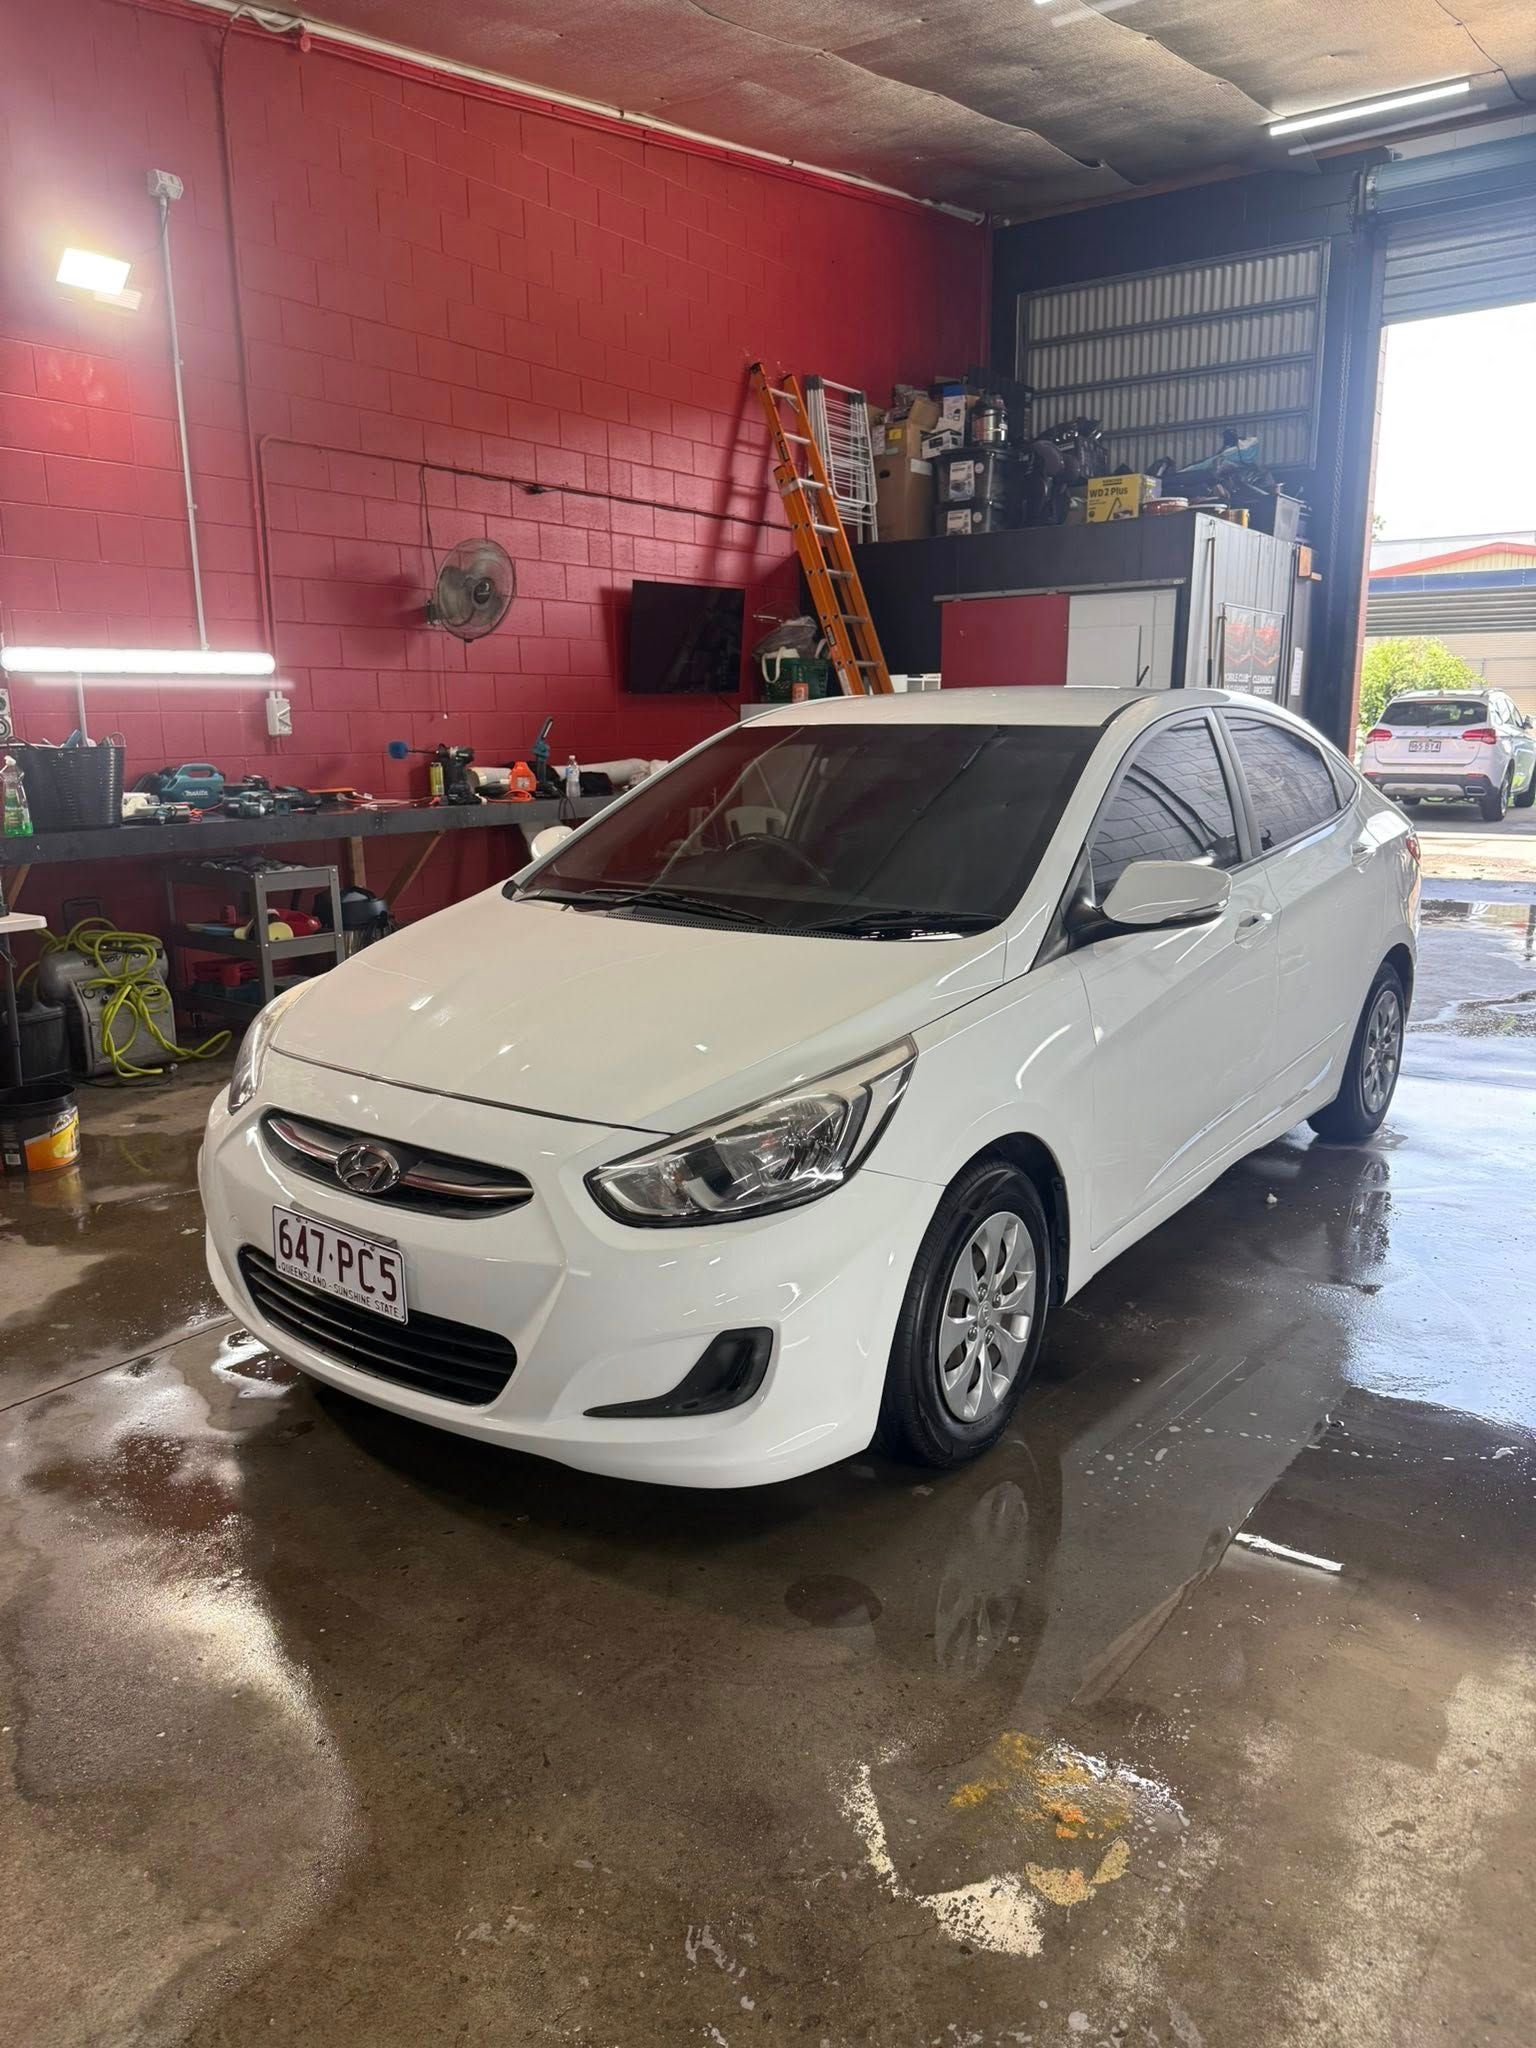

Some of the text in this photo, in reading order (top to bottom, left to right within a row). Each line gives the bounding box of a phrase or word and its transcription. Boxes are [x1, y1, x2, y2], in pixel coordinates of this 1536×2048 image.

[1089, 486, 1128, 498] WD 2 Plus
[281, 1262, 326, 1289] QUEENSLAND
[333, 1284, 371, 1307] SUNSHINE
[375, 1301, 399, 1317] STATE
